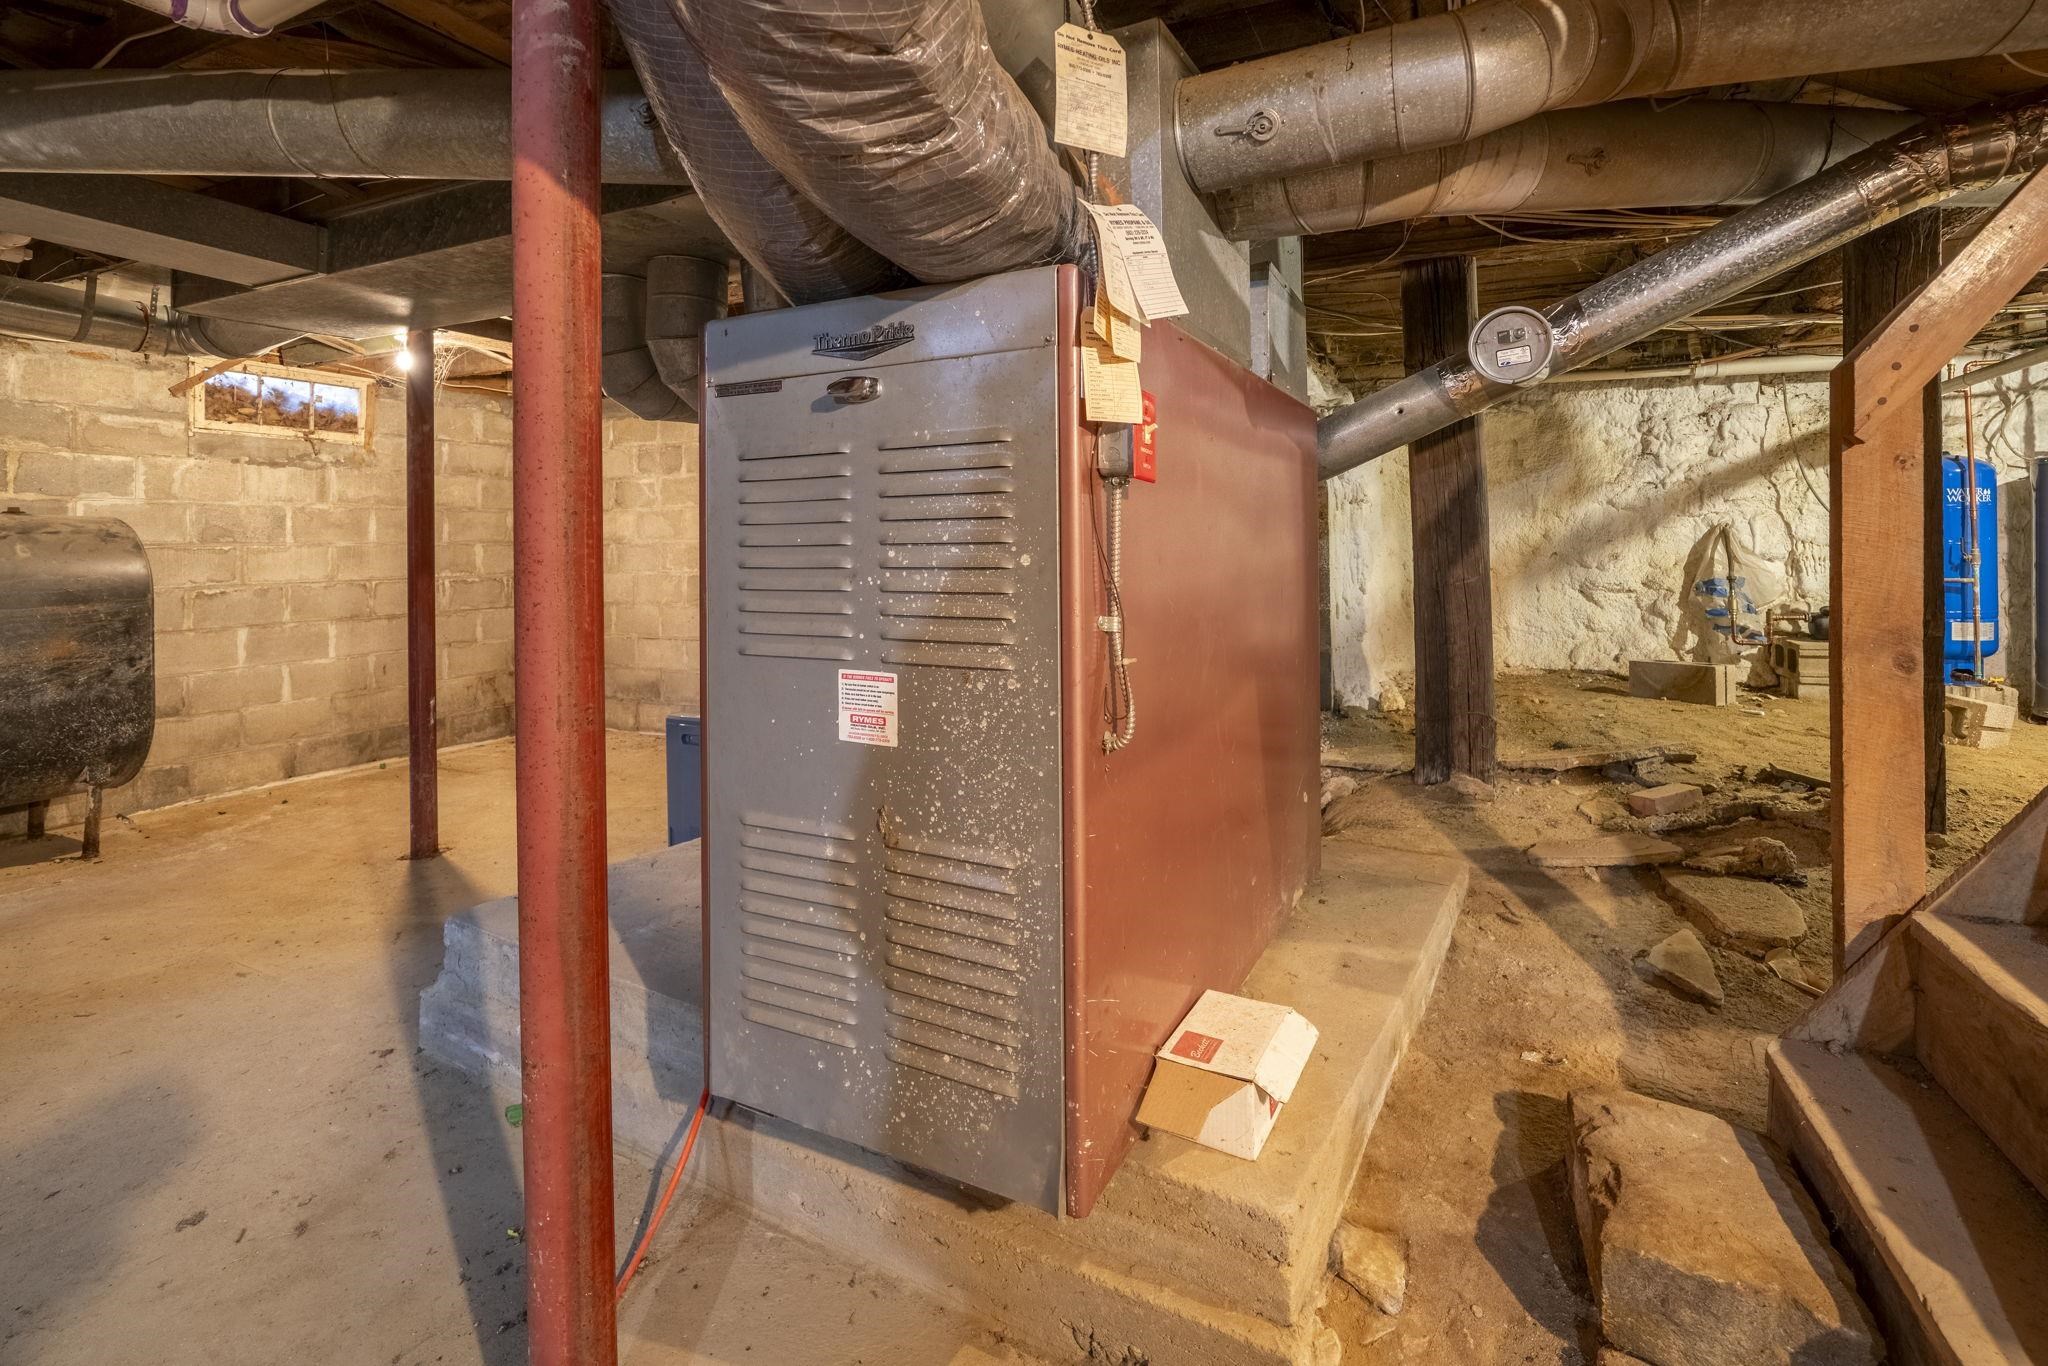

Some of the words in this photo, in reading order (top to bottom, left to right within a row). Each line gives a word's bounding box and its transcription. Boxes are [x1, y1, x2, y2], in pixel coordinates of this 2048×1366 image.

[1076, 37, 1096, 48] Remove
[1075, 48, 1097, 61] HEATING
[852, 715, 885, 725] RYMES
